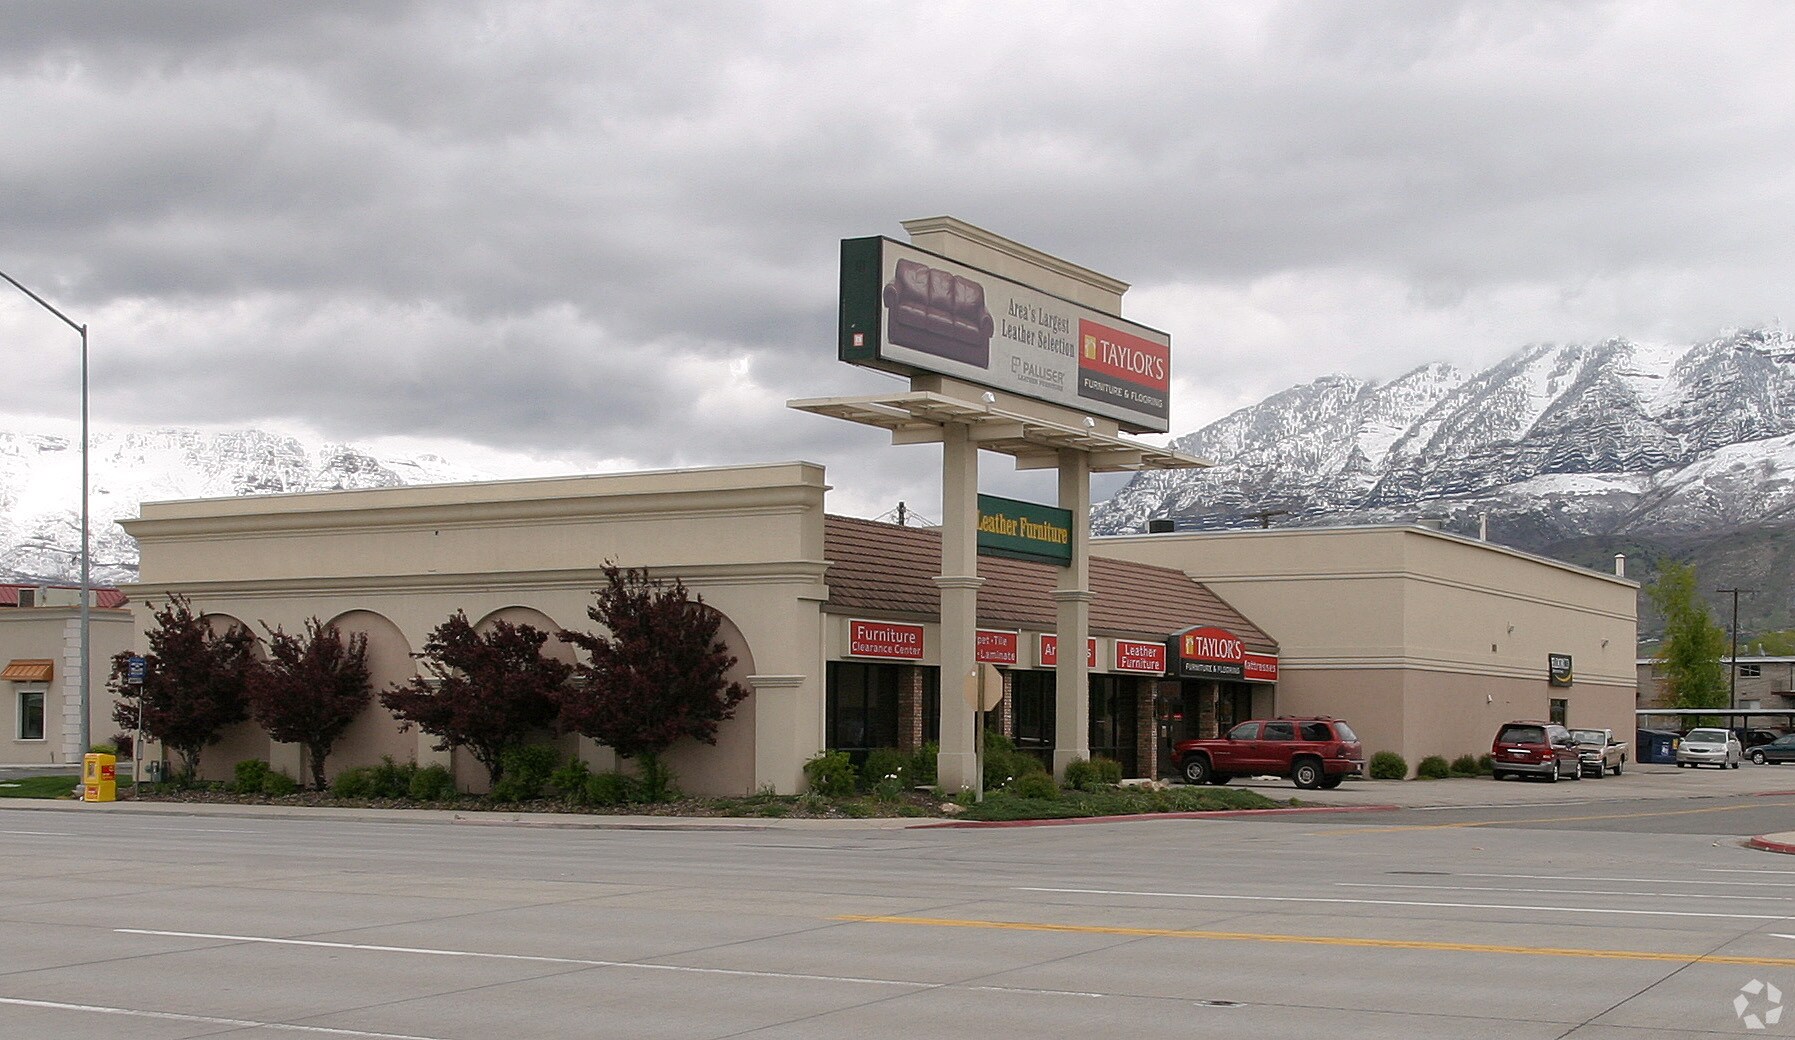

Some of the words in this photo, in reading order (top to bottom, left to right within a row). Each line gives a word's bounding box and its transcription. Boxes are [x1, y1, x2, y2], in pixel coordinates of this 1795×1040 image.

[1008, 298, 1036, 323] Area's
[1039, 307, 1070, 334] Largest
[1002, 319, 1035, 346] Leather
[1038, 331, 1075, 358] Selection
[1100, 340, 1164, 380] TAYLOR'S
[1023, 362, 1064, 385] PALLISER
[1084, 378, 1122, 397] FURNITURE
[1131, 391, 1163, 408] FLOORING
[977, 510, 1018, 536] Leather
[1020, 516, 1068, 544] Furniture
[857, 625, 916, 644] Furniture
[852, 641, 893, 654] Clearance
[894, 644, 921, 655] Center
[1125, 644, 1157, 658] Leather
[1196, 636, 1242, 660] TAYLOR'S
[1121, 656, 1160, 670] Furniture
